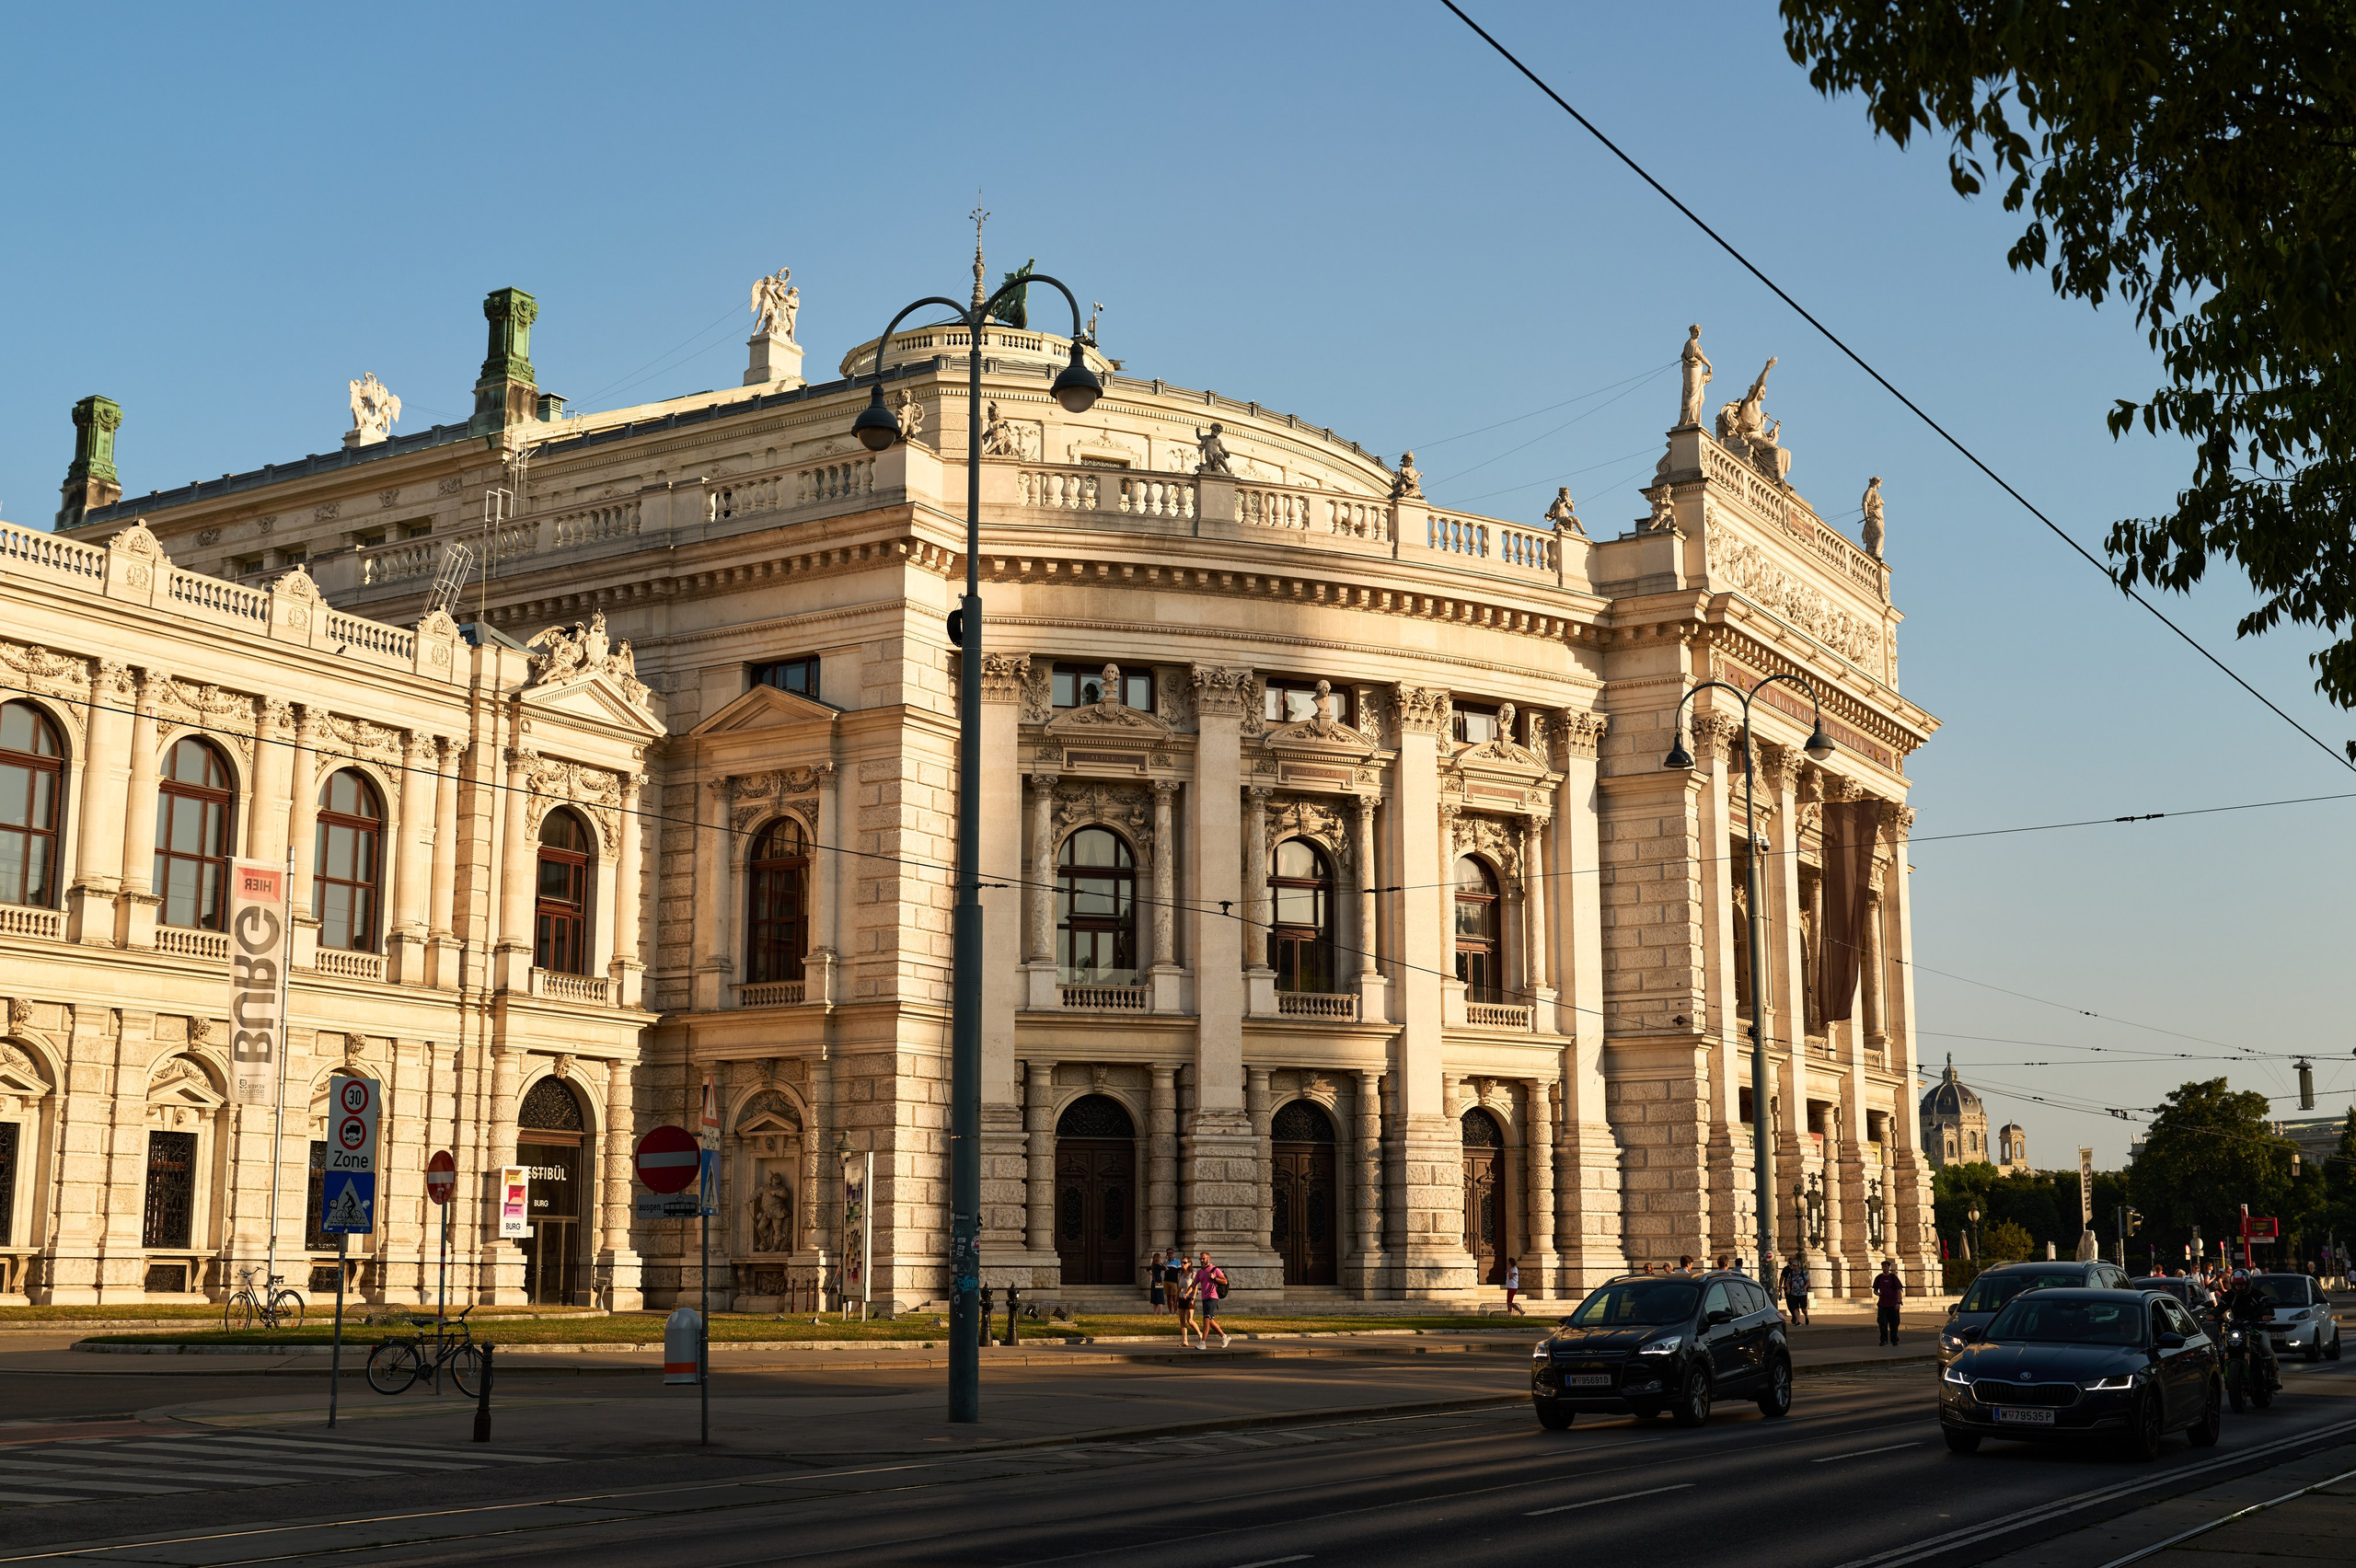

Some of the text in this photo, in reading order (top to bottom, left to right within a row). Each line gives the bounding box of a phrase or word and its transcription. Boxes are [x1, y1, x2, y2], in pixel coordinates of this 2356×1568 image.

[348, 1090, 362, 1105] 30
[333, 1150, 368, 1168] Zone
[528, 1165, 567, 1182] ESTIBÜL
[2083, 1162, 2092, 1211] BURG
[534, 1199, 549, 1207] BURG
[638, 1203, 663, 1213] ausgen.
[505, 1222, 521, 1230] BURG
[2001, 1410, 2007, 1419] W
